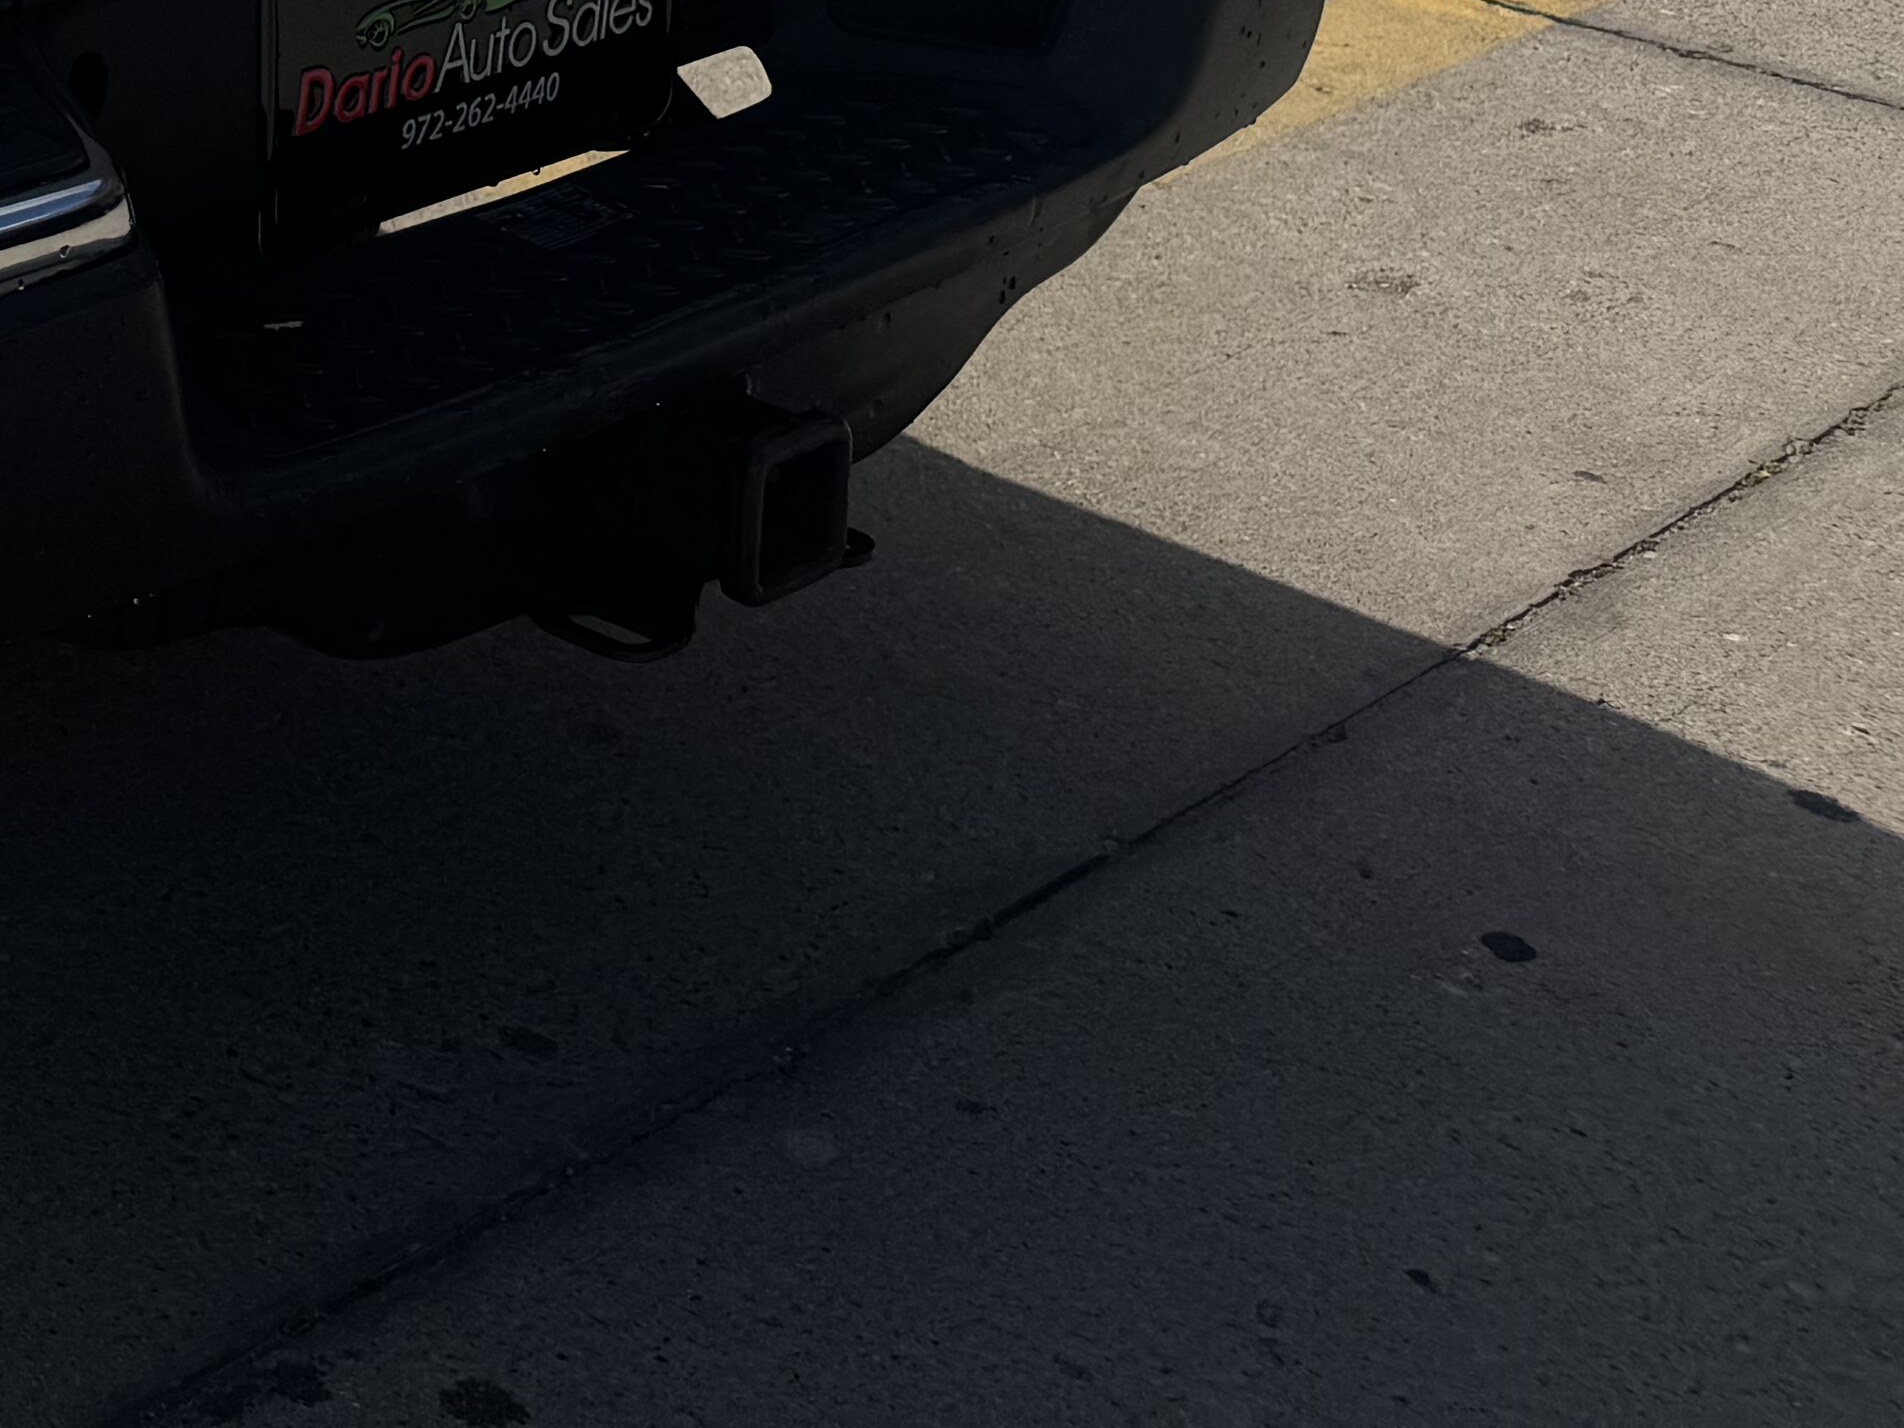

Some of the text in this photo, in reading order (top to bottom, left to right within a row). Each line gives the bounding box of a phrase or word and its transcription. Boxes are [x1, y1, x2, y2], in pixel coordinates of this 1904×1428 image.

[294, 46, 437, 137] Dario
[433, 15, 537, 94] Auto
[400, 72, 561, 150] 972-262-4440
